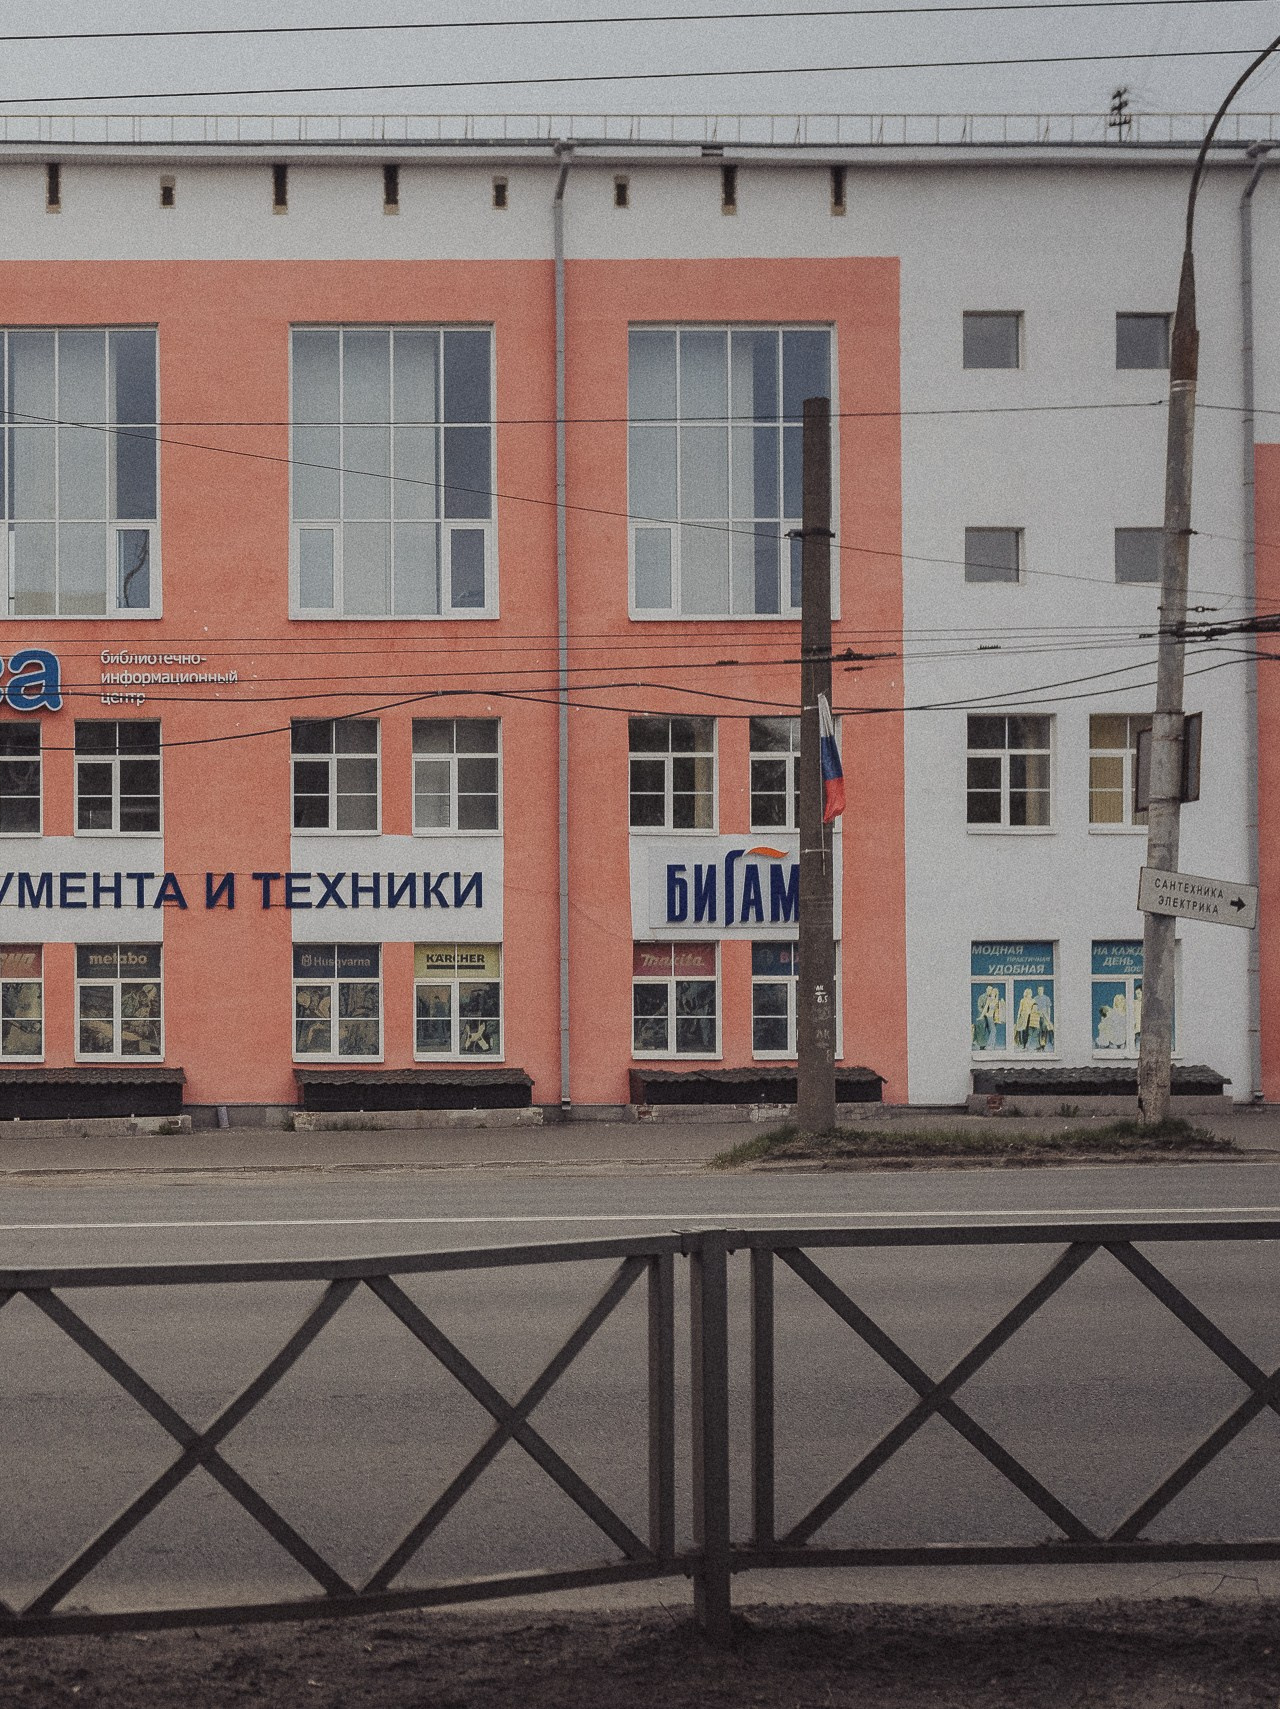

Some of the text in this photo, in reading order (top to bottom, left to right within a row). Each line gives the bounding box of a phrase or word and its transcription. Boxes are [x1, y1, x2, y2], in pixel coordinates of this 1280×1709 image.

[100, 650, 207, 665] библиотечно-
[101, 670, 238, 687] информационный
[100, 692, 146, 707] центр
[206, 872, 235, 909] И
[252, 872, 483, 909] ТЕХНИКИ
[666, 849, 800, 928] БИГАМ
[1154, 878, 1224, 899] САНТЕХНИКА
[1158, 895, 1219, 914] ЭЛЕКТРИКА
[972, 945, 1024, 956] МОДНАЯ
[1093, 945, 1144, 956] НА КАЖД
[89, 952, 148, 965] metabo
[314, 957, 370, 968] Husqvarna
[426, 953, 486, 963] KÄRCHER
[1103, 957, 1134, 967] ДЕНЬ
[988, 964, 1045, 975] УДОБНАЯ
